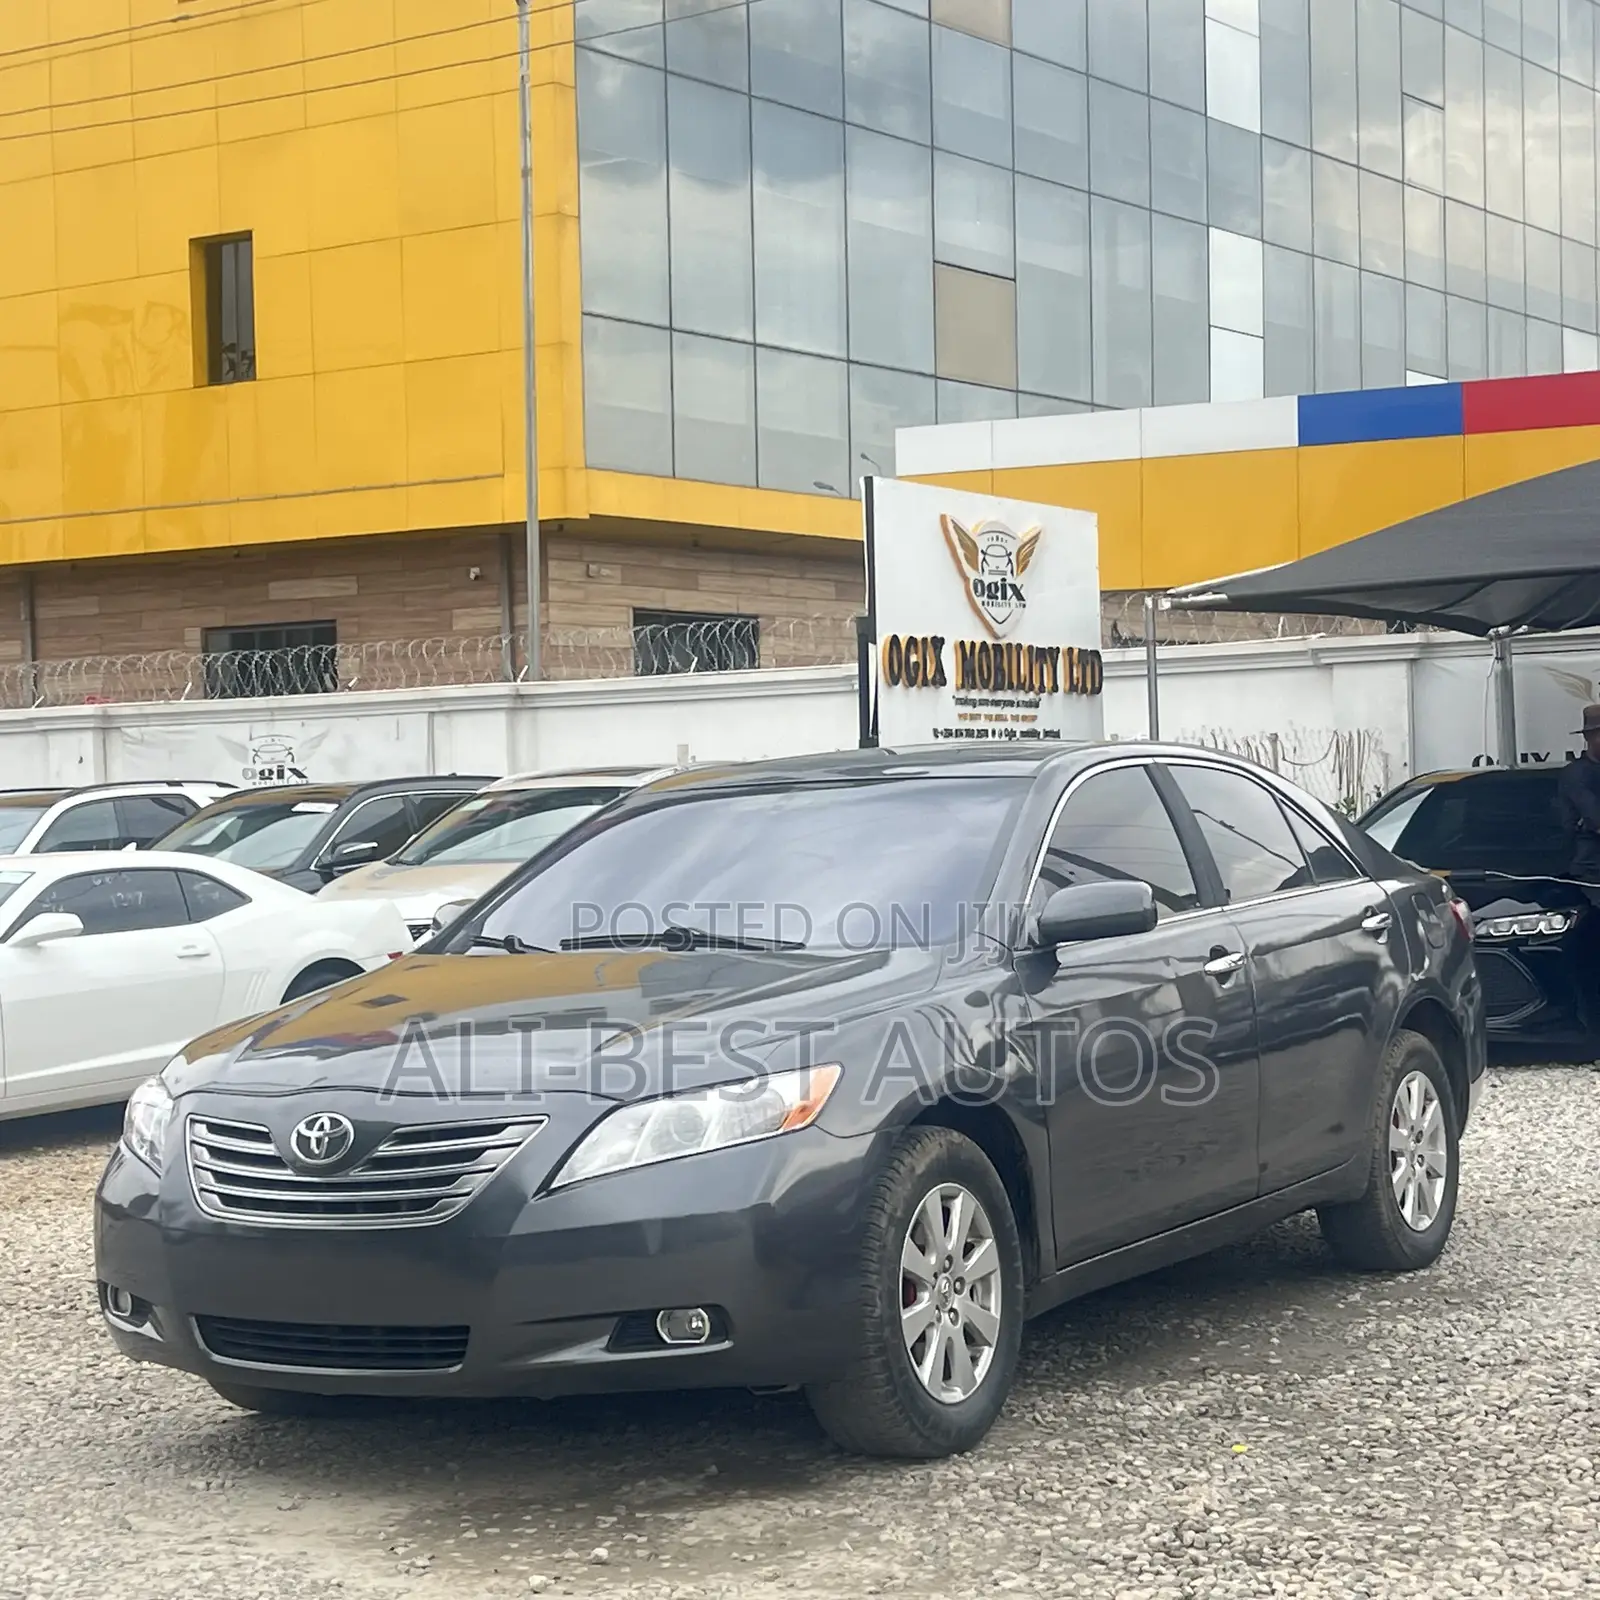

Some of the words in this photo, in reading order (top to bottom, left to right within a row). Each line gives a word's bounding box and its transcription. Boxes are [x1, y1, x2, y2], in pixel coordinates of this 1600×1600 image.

[882, 634, 947, 688] OGIX
[954, 640, 1060, 694] MOBILITY
[1062, 646, 1103, 695] LTD
